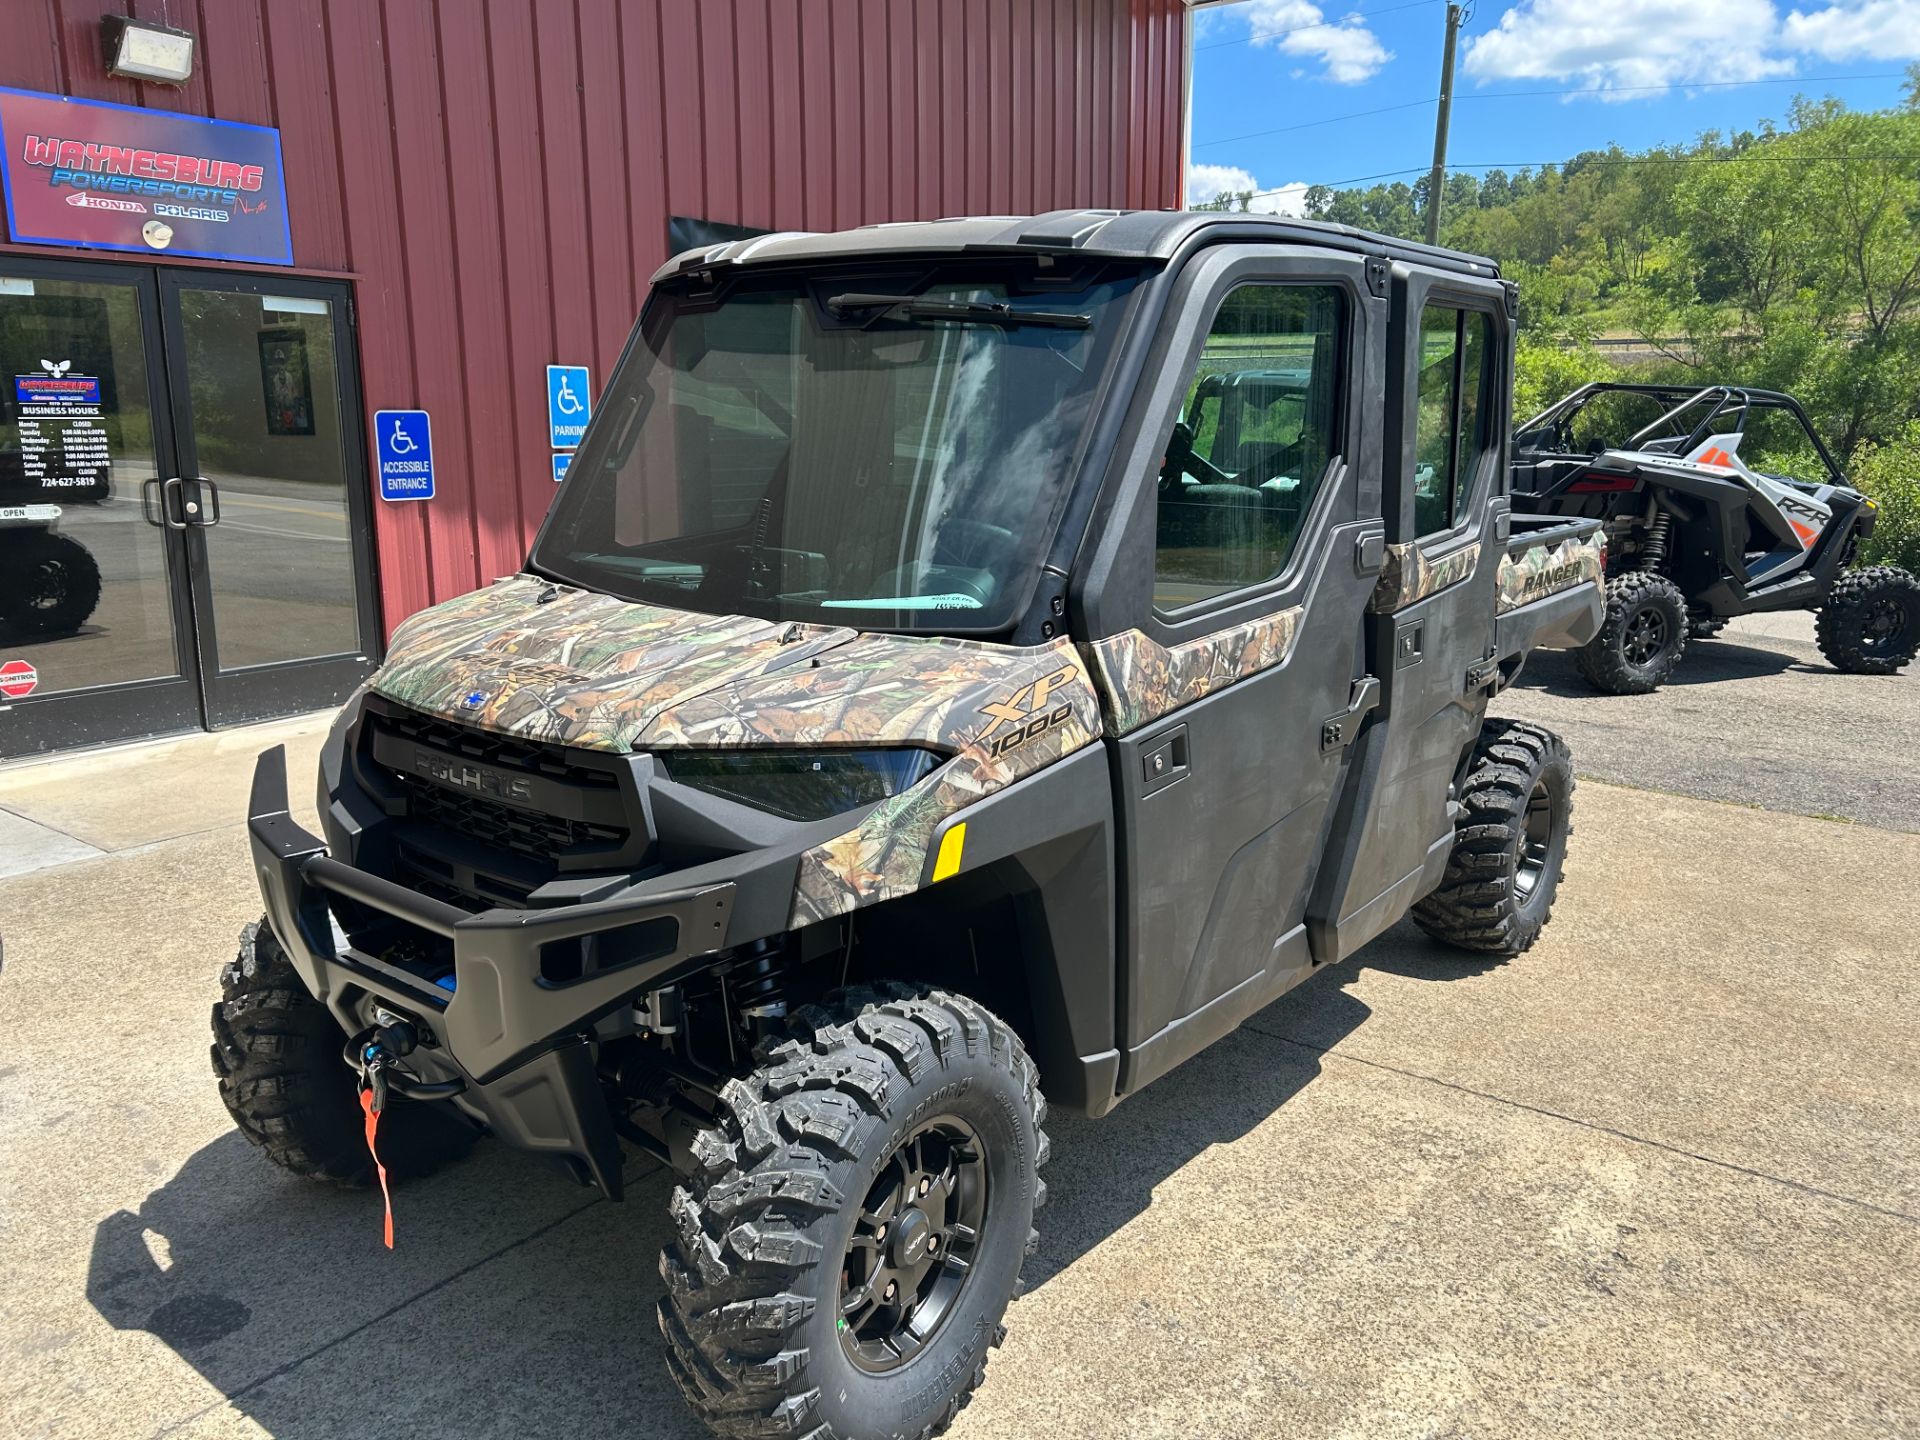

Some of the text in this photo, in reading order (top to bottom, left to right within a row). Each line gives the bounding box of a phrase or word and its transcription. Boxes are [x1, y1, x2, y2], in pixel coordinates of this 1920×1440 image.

[24, 136, 263, 191] WAYNESBURG
[51, 169, 238, 205] POWERSPORTS
[86, 198, 229, 222] HONDA POLARIS
[23, 407, 99, 415] BUSINESS HOURS
[19, 421, 39, 429] Monday
[20, 429, 41, 438] Tuesday
[21, 437, 50, 445] Wednesday
[24, 461, 47, 469] Saturday
[384, 461, 429, 473] ACCESSIBLE
[41, 477, 95, 487] 724-627-5819
[388, 478, 427, 490] ENTRANCE
[3, 509, 25, 517] OPEN
[1777, 496, 1831, 526] RZR
[1523, 561, 1581, 594] RANGER
[968, 664, 1079, 747] XP
[990, 701, 1073, 759] 1000
[416, 750, 531, 800] POLARIS
